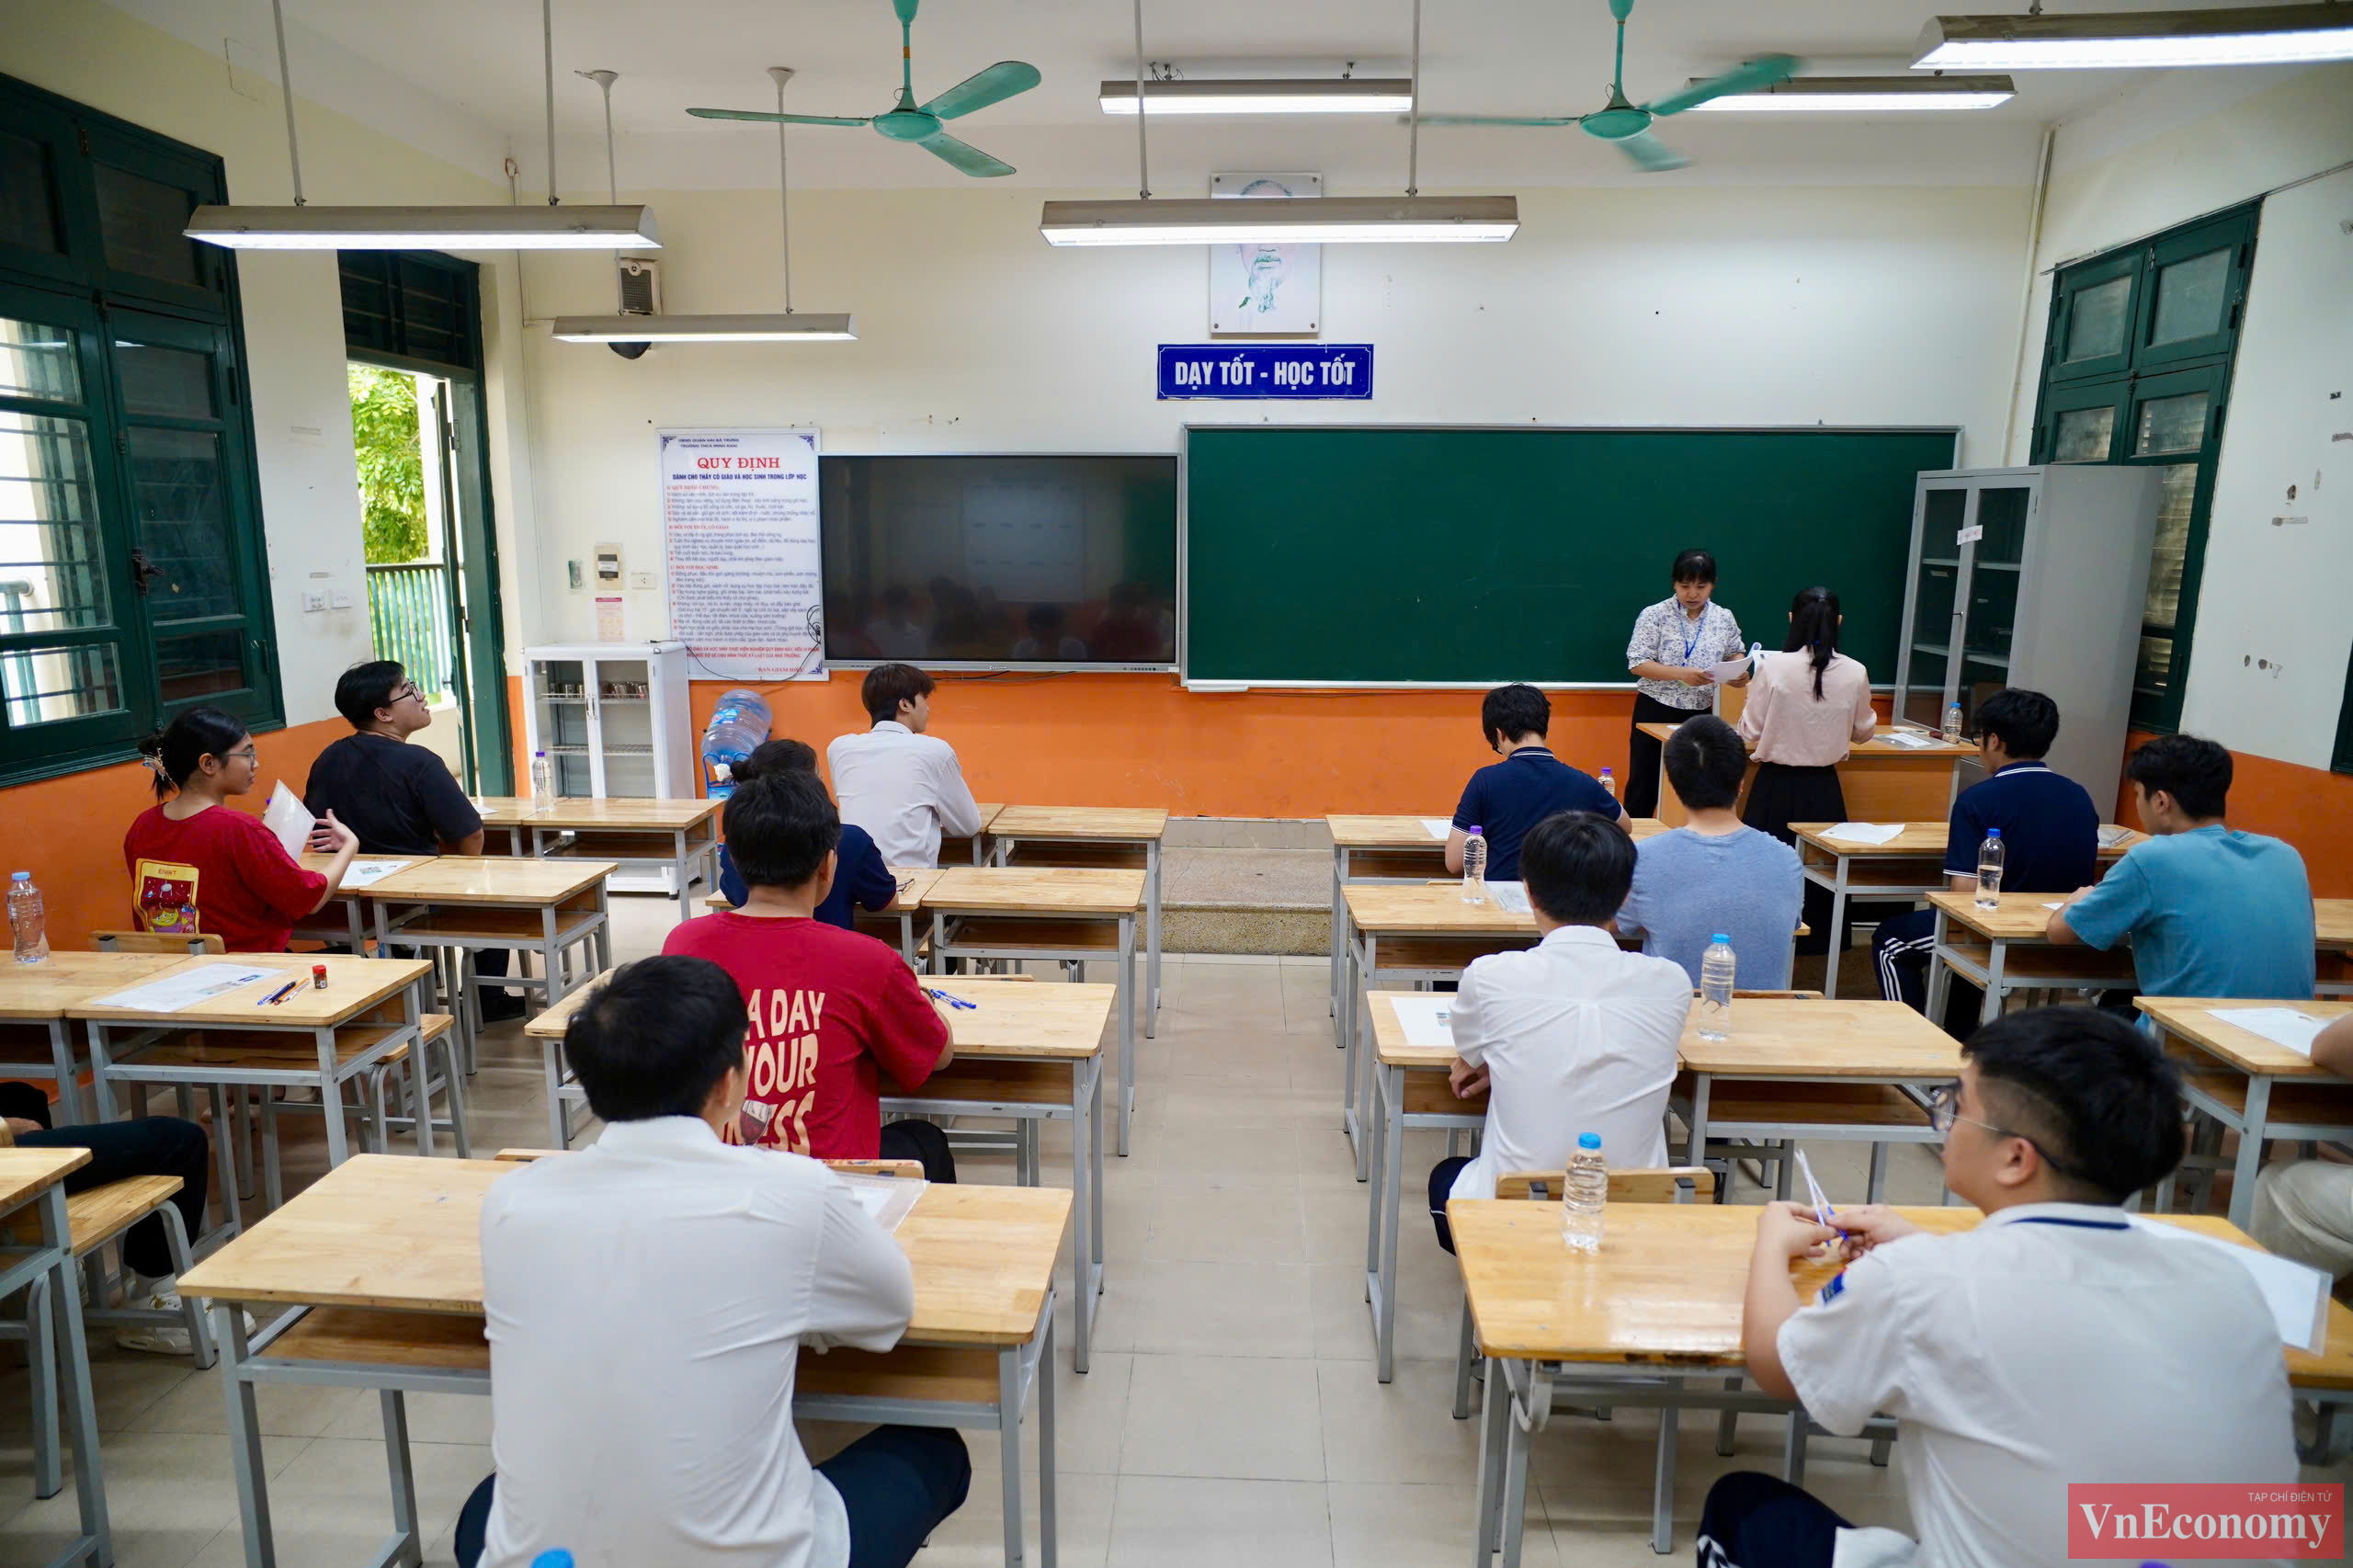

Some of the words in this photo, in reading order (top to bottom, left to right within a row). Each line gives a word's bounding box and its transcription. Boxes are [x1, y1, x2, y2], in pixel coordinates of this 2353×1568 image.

[1176, 361, 1213, 390] DẠY
[1220, 353, 1255, 386] TỐT
[1274, 362, 1313, 390] HỌC
[1320, 353, 1356, 386] TỐT
[698, 457, 733, 469] QUY
[737, 457, 780, 472] ĐỊNH
[770, 989, 825, 1037] DAY
